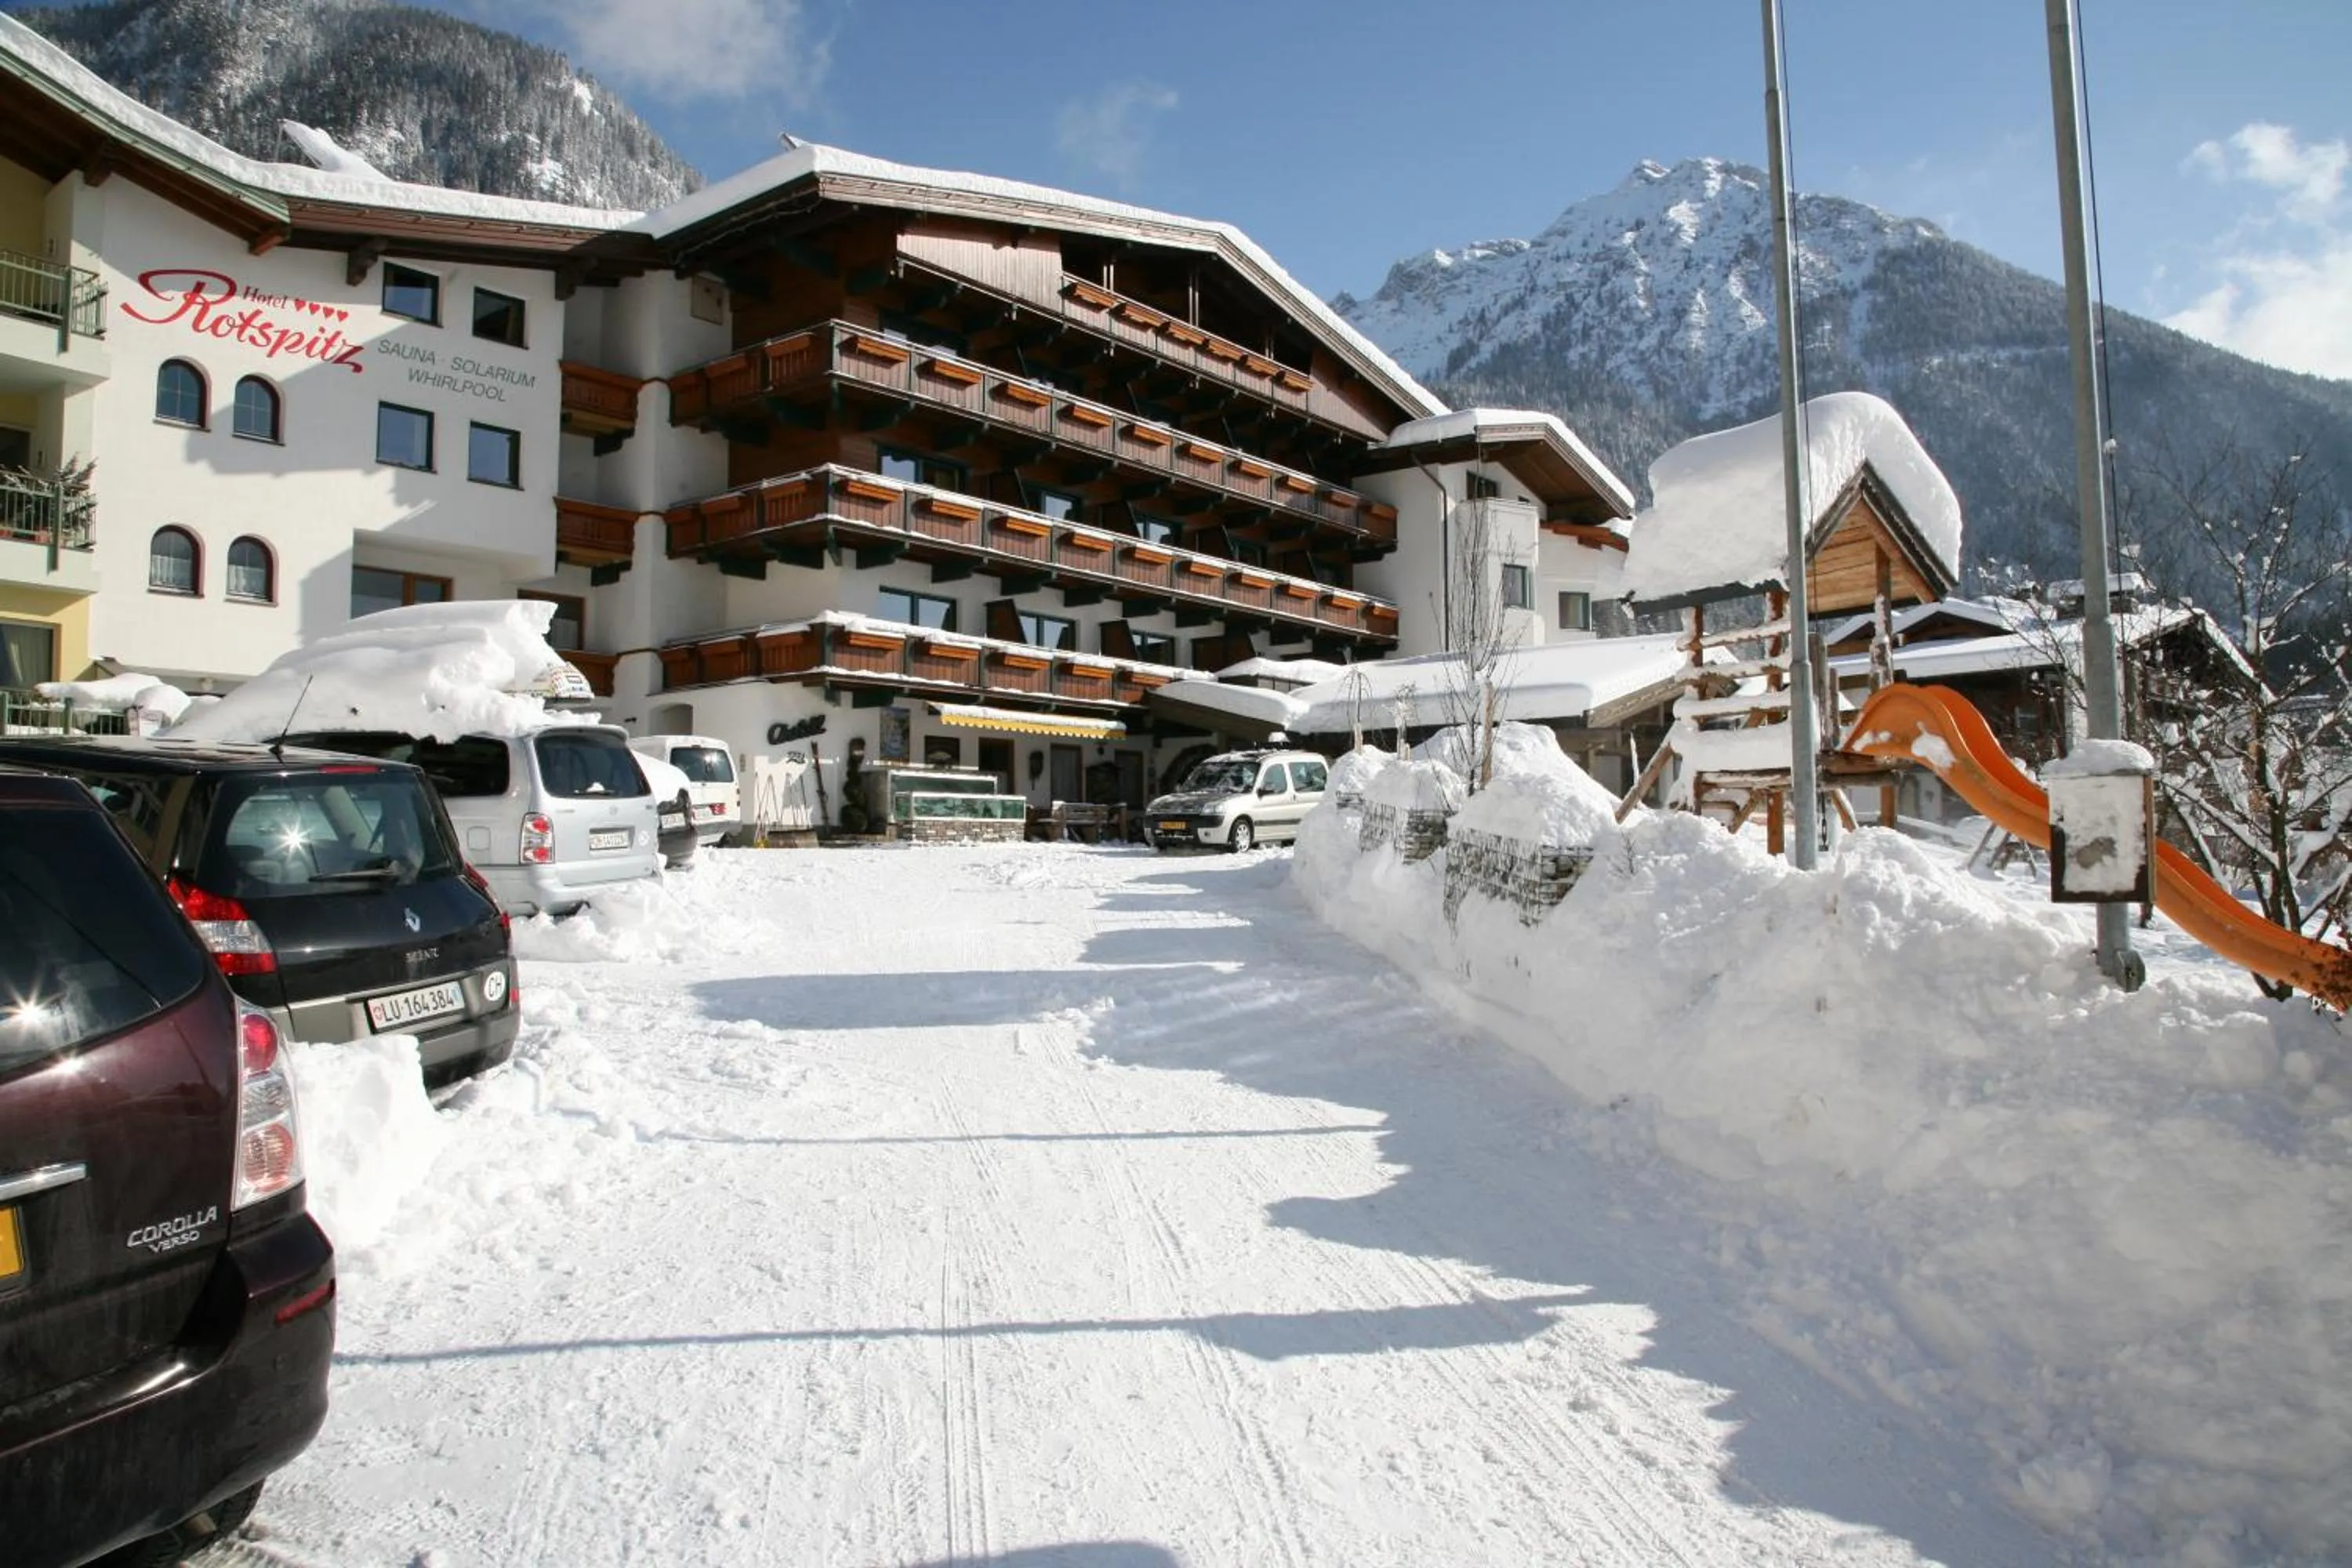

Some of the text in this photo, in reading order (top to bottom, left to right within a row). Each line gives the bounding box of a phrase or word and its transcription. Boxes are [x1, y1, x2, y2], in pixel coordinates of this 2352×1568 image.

[242, 285, 289, 310] Hotel
[120, 269, 365, 374] Rotspitz
[377, 339, 536, 388] SAUNA SOLARIUM
[408, 367, 506, 402] WHIRLPOOL
[488, 973, 504, 999] CH
[126, 1205, 217, 1247] COROLLA
[148, 1230, 200, 1253] VERSO
